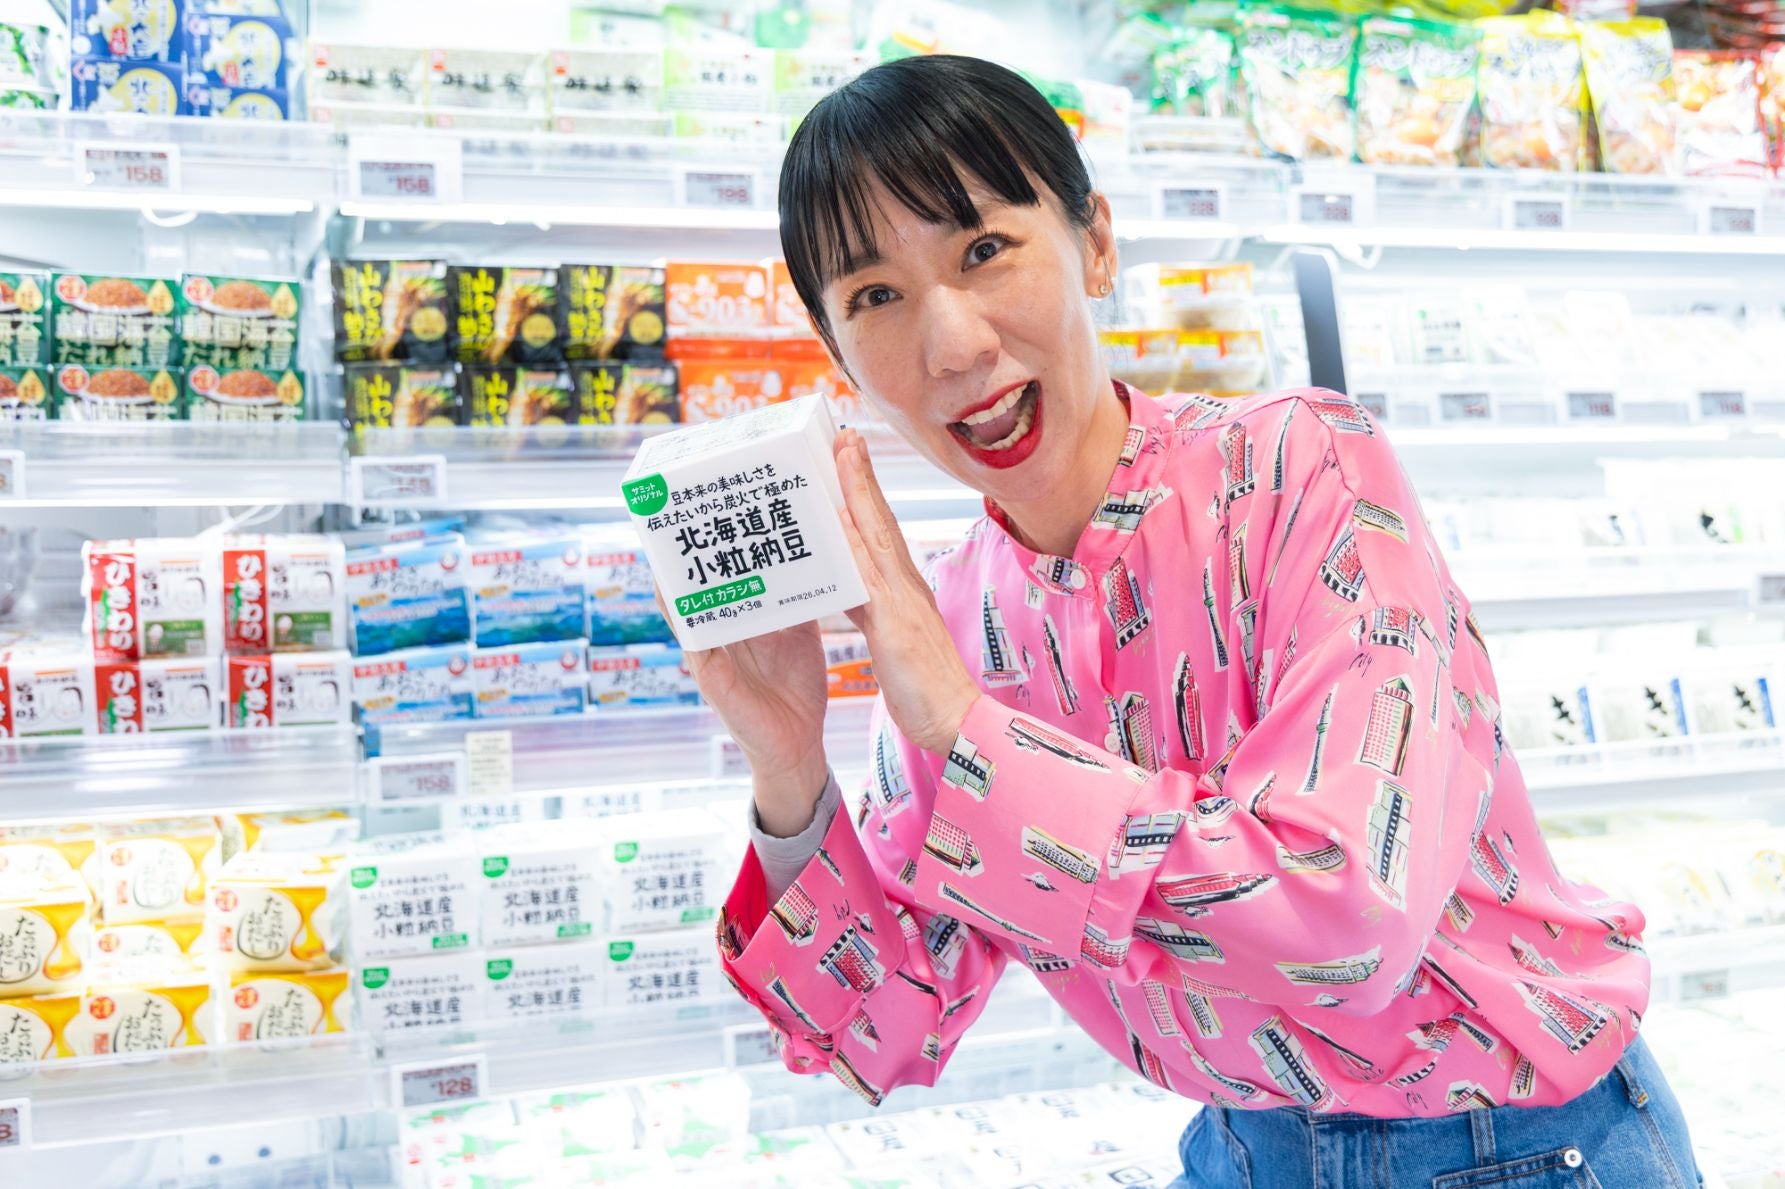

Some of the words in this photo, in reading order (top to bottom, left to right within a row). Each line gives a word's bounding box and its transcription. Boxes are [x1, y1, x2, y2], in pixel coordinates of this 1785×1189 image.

[631, 482, 656, 495] サミット
[670, 463, 776, 507] 豆本来の美味しさを
[631, 491, 664, 505] オリジナル
[647, 474, 808, 532] 伝えたいから炭火で極めた
[675, 498, 797, 557] 北海道産
[687, 530, 813, 585] 小粒納豆
[104, 561, 133, 650] ひきわり
[236, 554, 264, 641] ひきわり
[633, 870, 704, 893] 北海道産
[374, 896, 451, 920] 北海道産
[504, 886, 578, 908] 北海道産
[632, 889, 704, 911] 小粒納豆
[503, 905, 580, 926] 小粒納豆
[374, 917, 453, 938] 小粒納豆
[628, 969, 700, 990] 北海道産
[384, 996, 461, 1018] 北海道産
[508, 987, 581, 1009] 北海道産
[437, 1077, 472, 1096] 128
